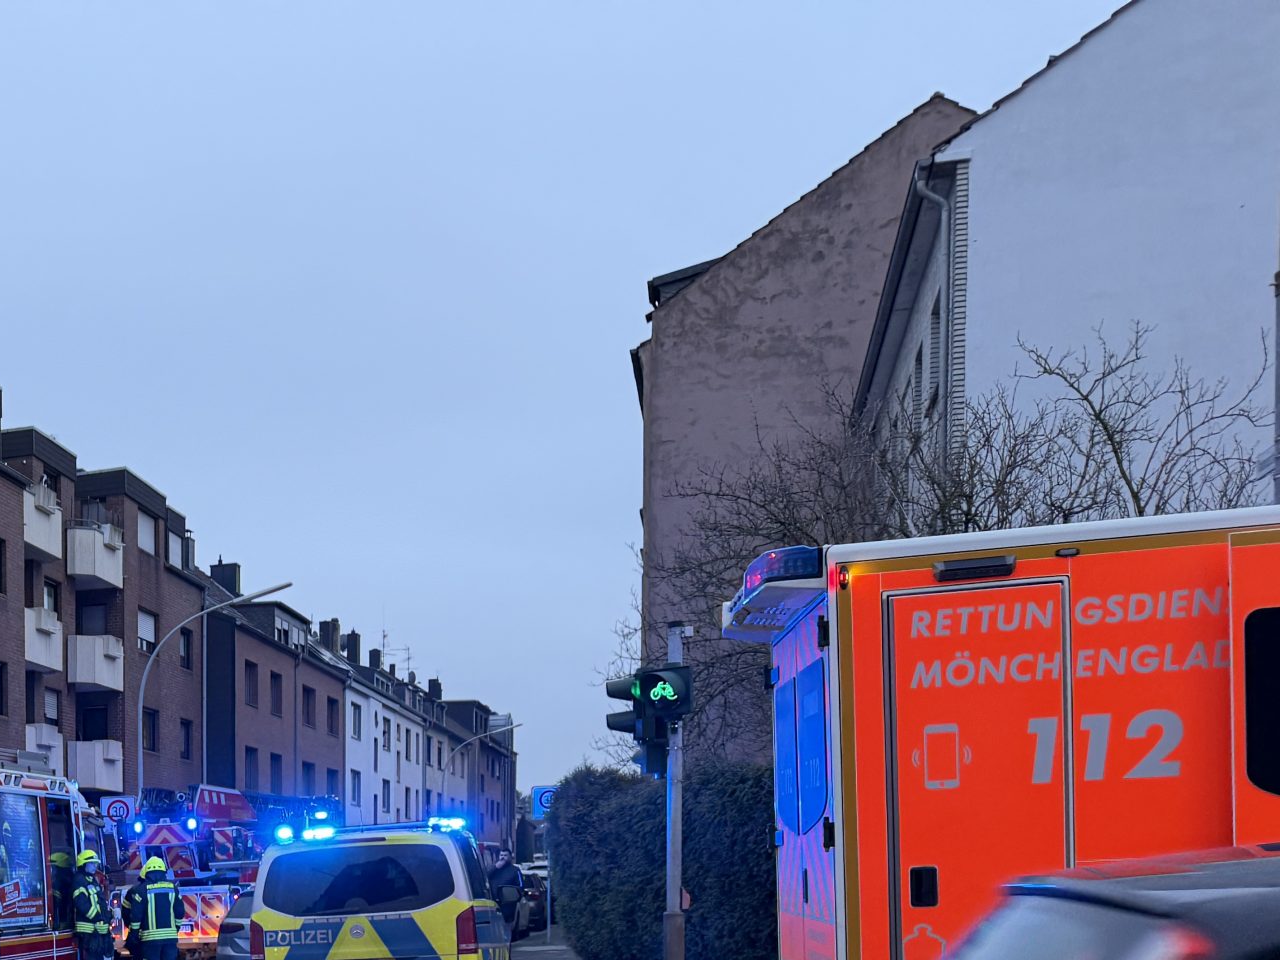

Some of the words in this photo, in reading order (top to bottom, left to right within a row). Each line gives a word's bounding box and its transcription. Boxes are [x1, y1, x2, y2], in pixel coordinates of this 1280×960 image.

[910, 586, 1231, 639] RETTUNGSDIEN
[1027, 708, 1185, 784] 112
[111, 806, 125, 817] 30
[265, 929, 333, 946] POLIZEI
